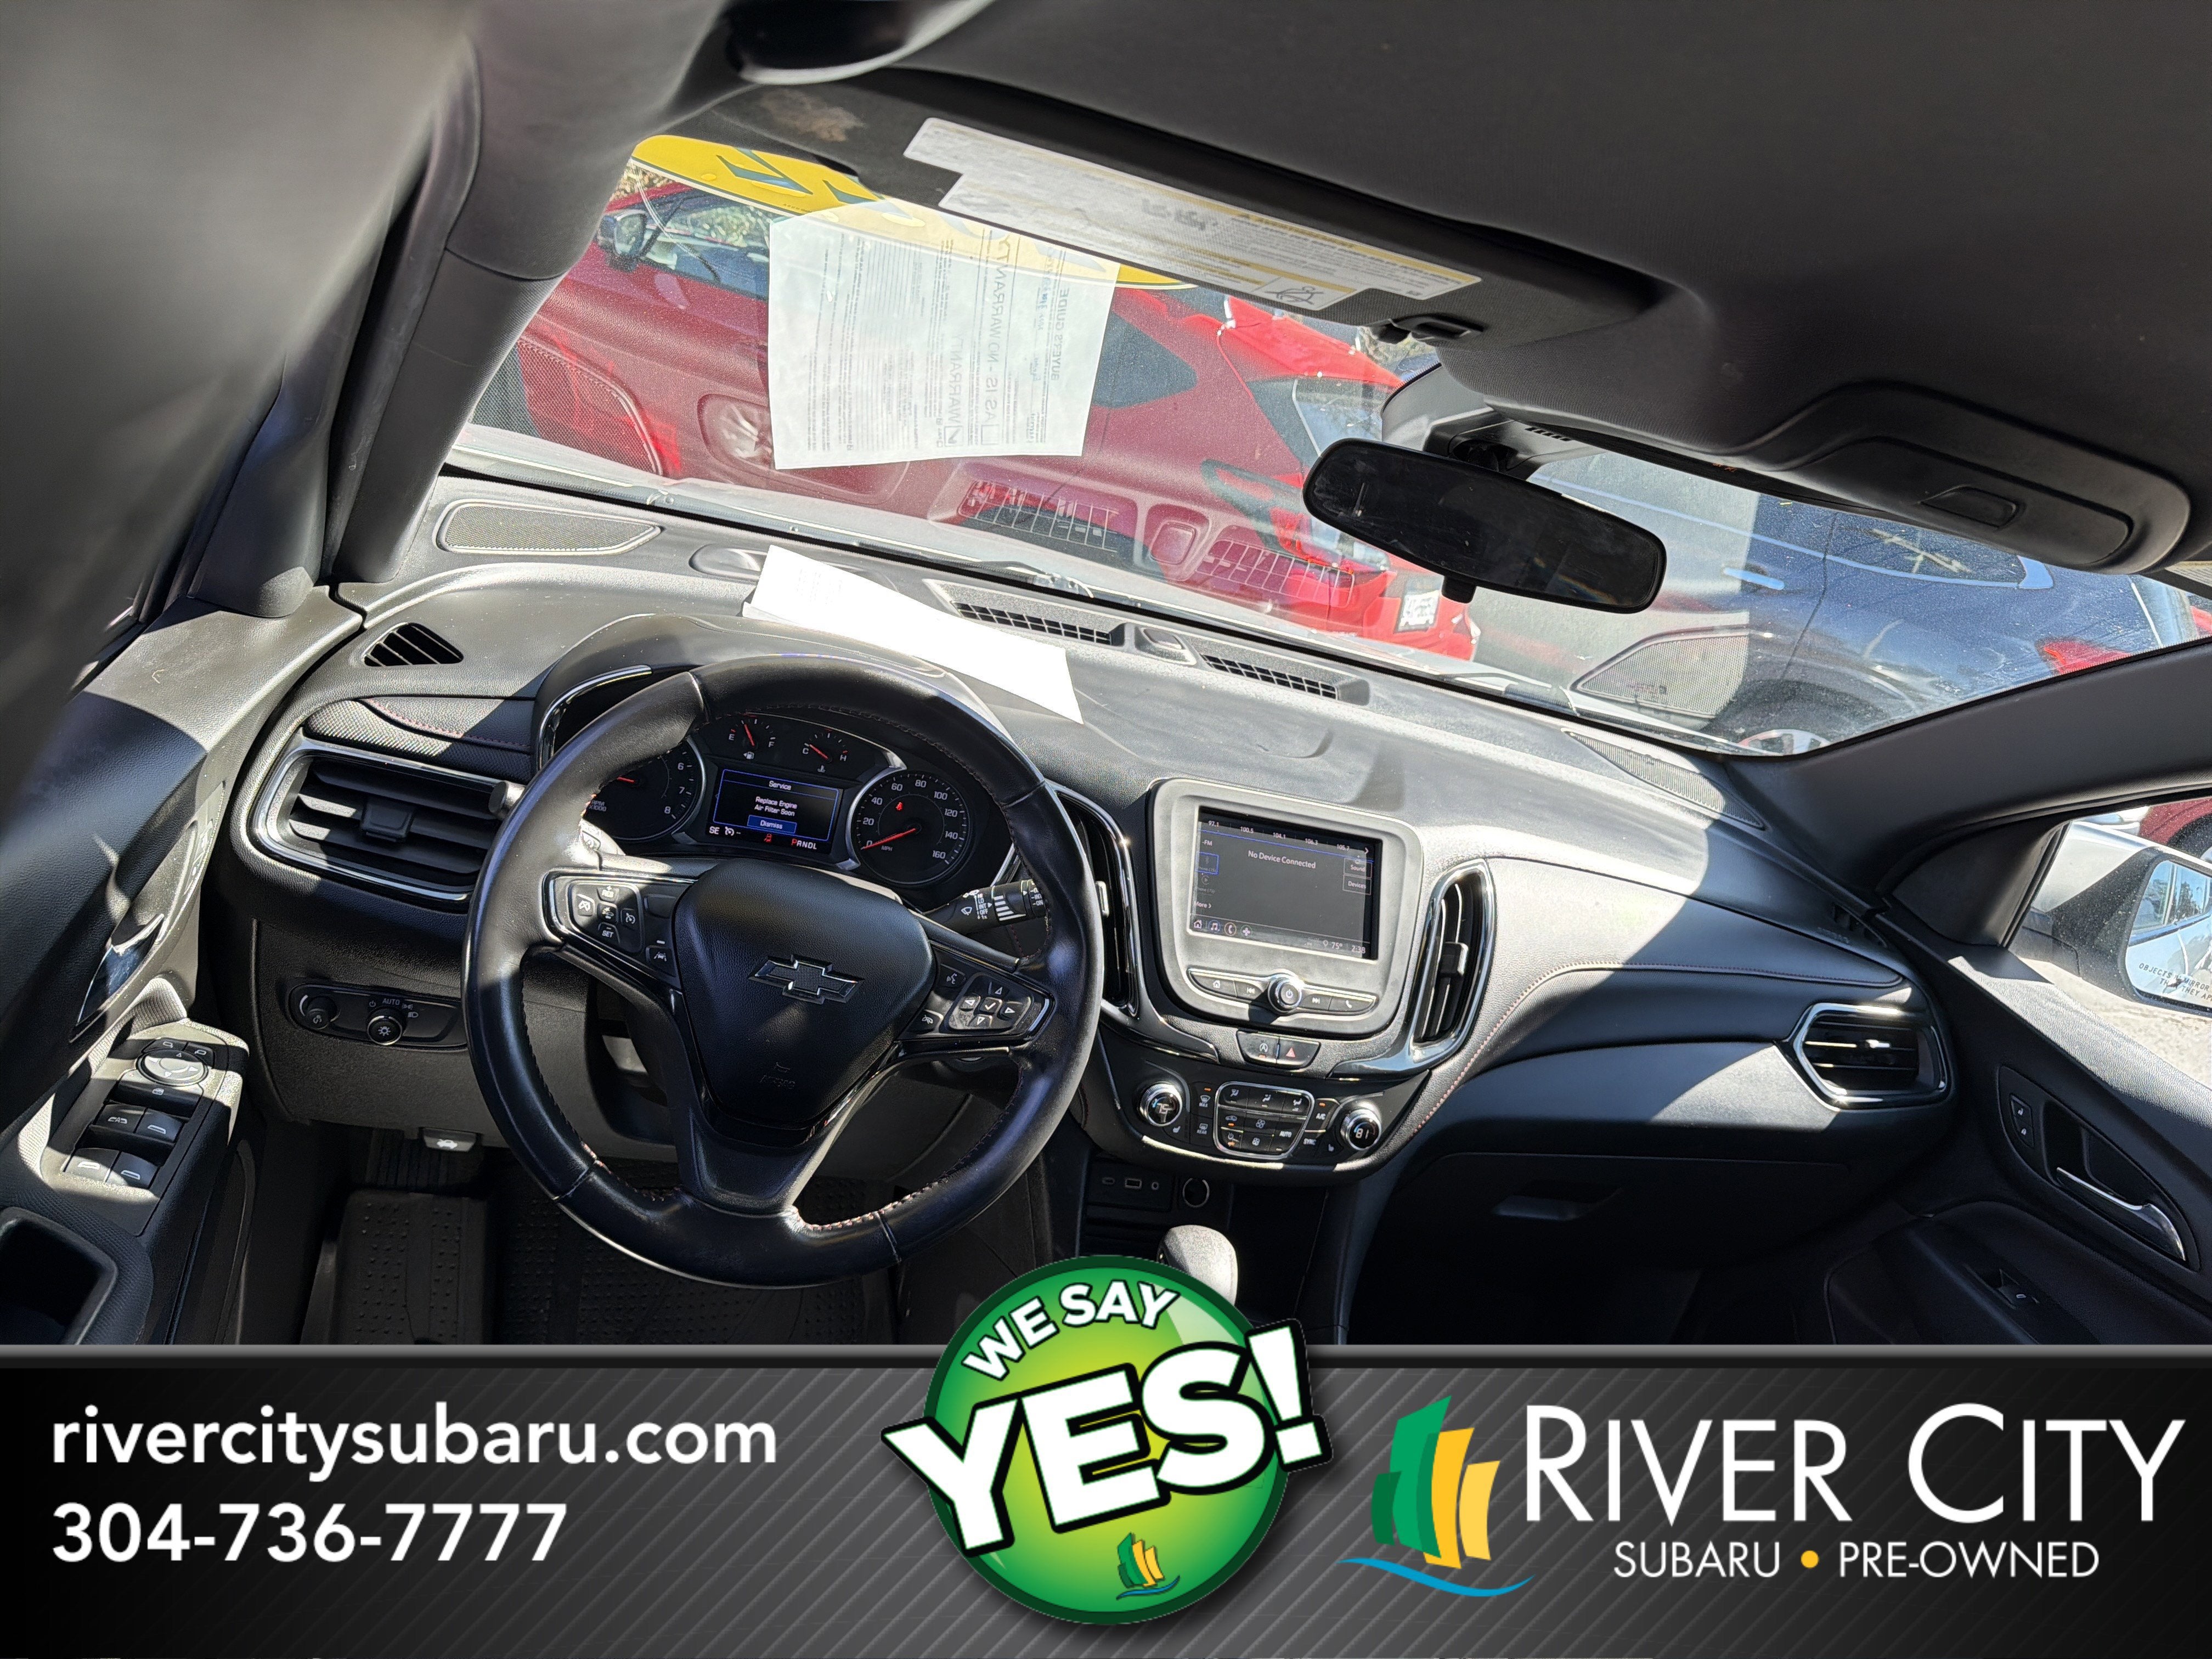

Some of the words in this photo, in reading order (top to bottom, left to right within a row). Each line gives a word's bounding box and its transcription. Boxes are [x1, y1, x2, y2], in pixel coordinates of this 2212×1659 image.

[678, 762, 684, 770] 6
[769, 781, 792, 791] Service
[891, 783, 903, 792] 60
[915, 779, 927, 788] 80
[679, 786, 685, 794] 7
[934, 791, 948, 800] 100
[755, 797, 778, 806] Replace
[779, 800, 797, 809] Engine
[871, 797, 883, 805] 40
[664, 806, 671, 814] 8
[944, 808, 958, 818] 120
[760, 820, 783, 830] Dismiss
[862, 817, 874, 826] 20
[709, 826, 720, 835] SE
[945, 831, 958, 840] 140
[1272, 832, 1286, 840] 104.1
[791, 838, 817, 850] PRNDL
[932, 850, 946, 859] 160
[1248, 850, 1258, 859] No
[1259, 852, 1280, 863] Device
[1281, 856, 1316, 869] Connected
[1347, 881, 1367, 889] Devices
[602, 930, 614, 939] SET
[1331, 941, 1343, 950] 75°
[1351, 945, 1366, 954] 2:38
[2138, 963, 2172, 979] OBJECTS
[2183, 977, 2210, 991] MIRROR
[2181, 985, 2200, 996] THEY
[382, 997, 400, 1006] AUTO
[1355, 1128, 1369, 1139] 81
